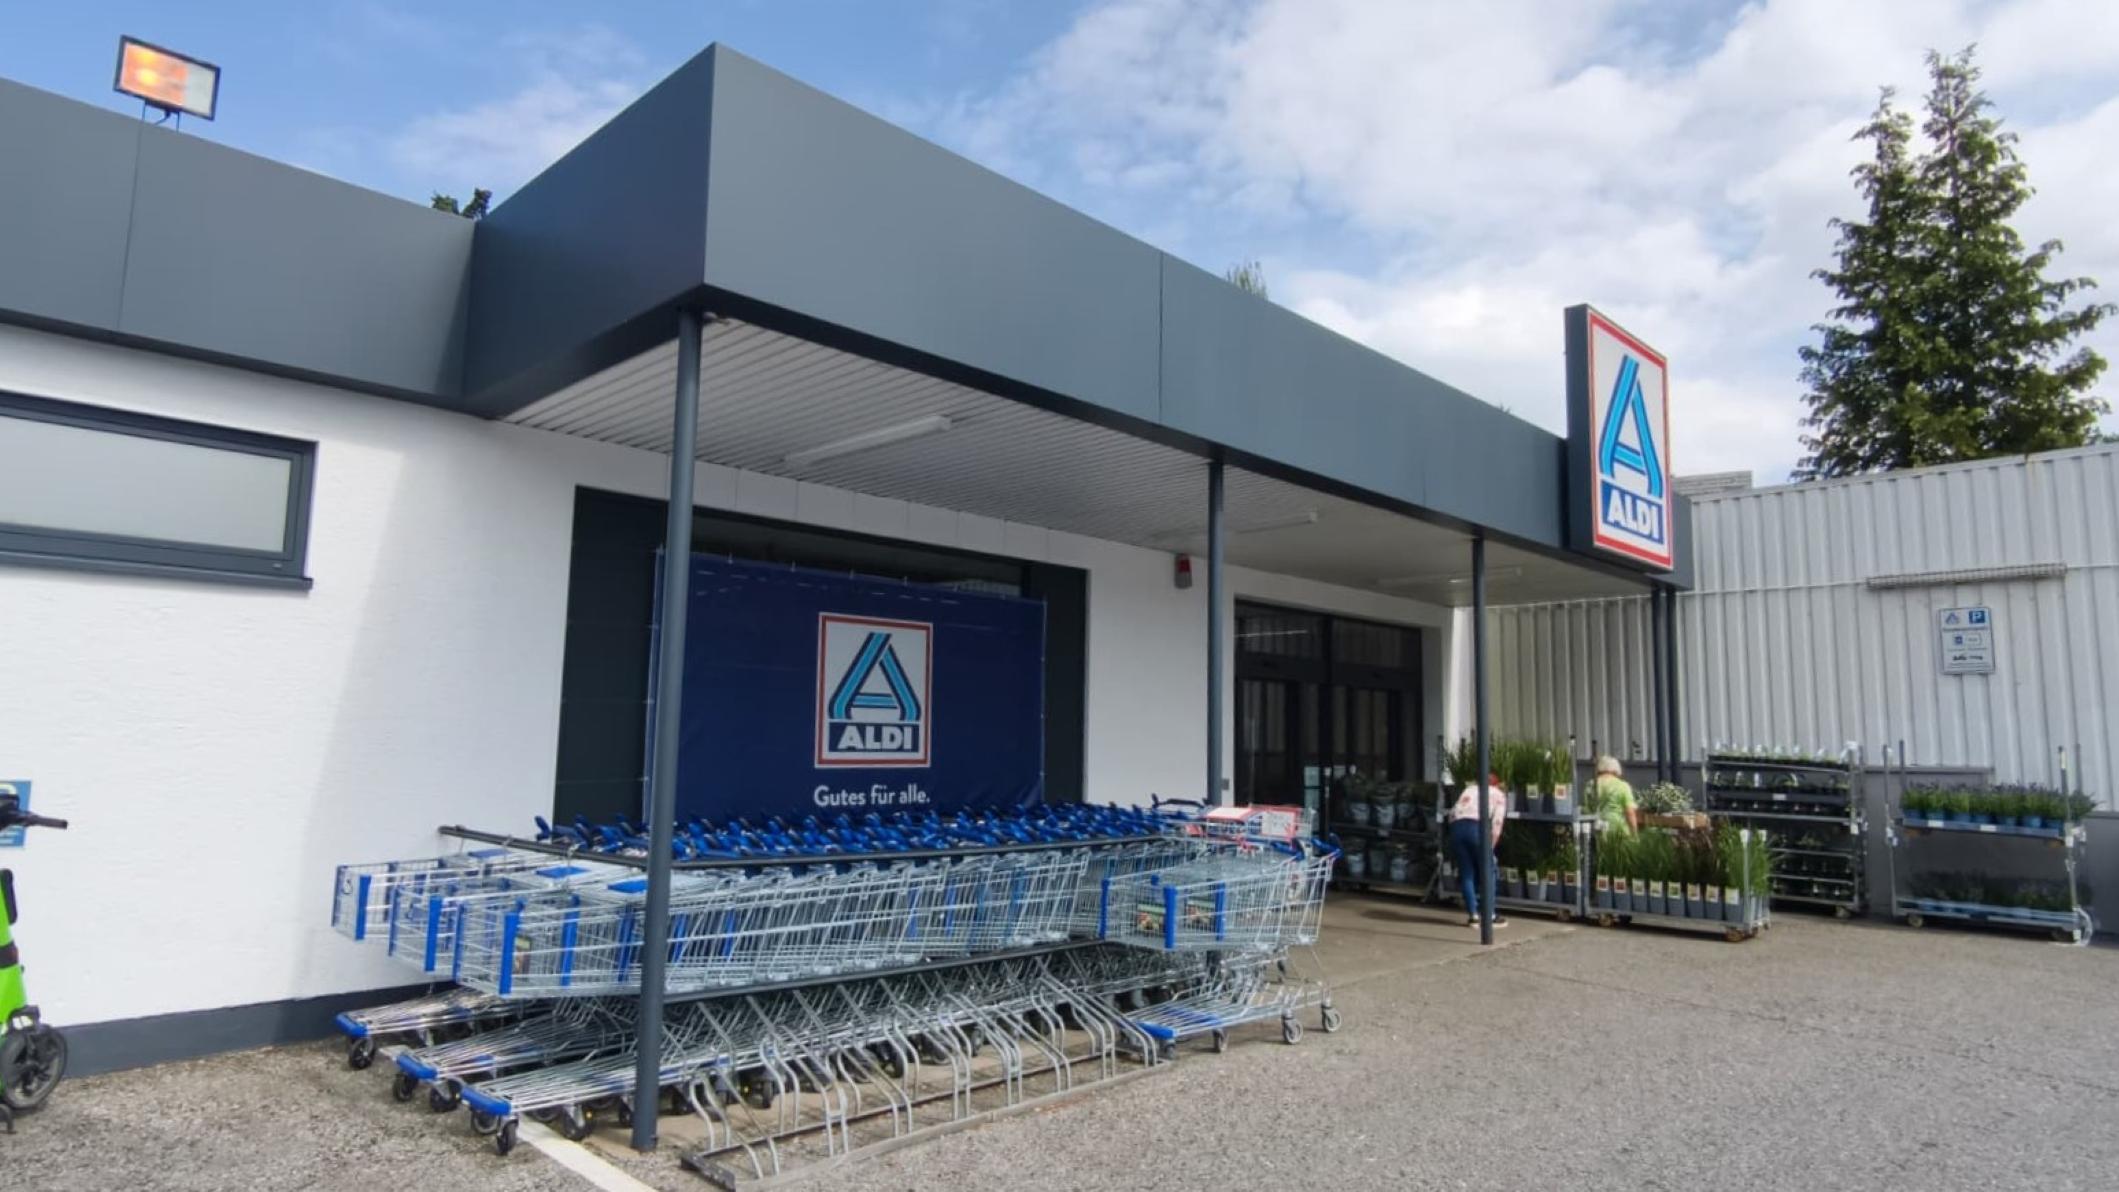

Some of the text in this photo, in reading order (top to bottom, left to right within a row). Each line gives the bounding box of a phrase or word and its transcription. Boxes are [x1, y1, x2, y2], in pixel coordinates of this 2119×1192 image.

[1607, 489, 1660, 539] ALDI
[837, 725, 913, 750] ALDI
[814, 783, 931, 806] Gutes für alle.
